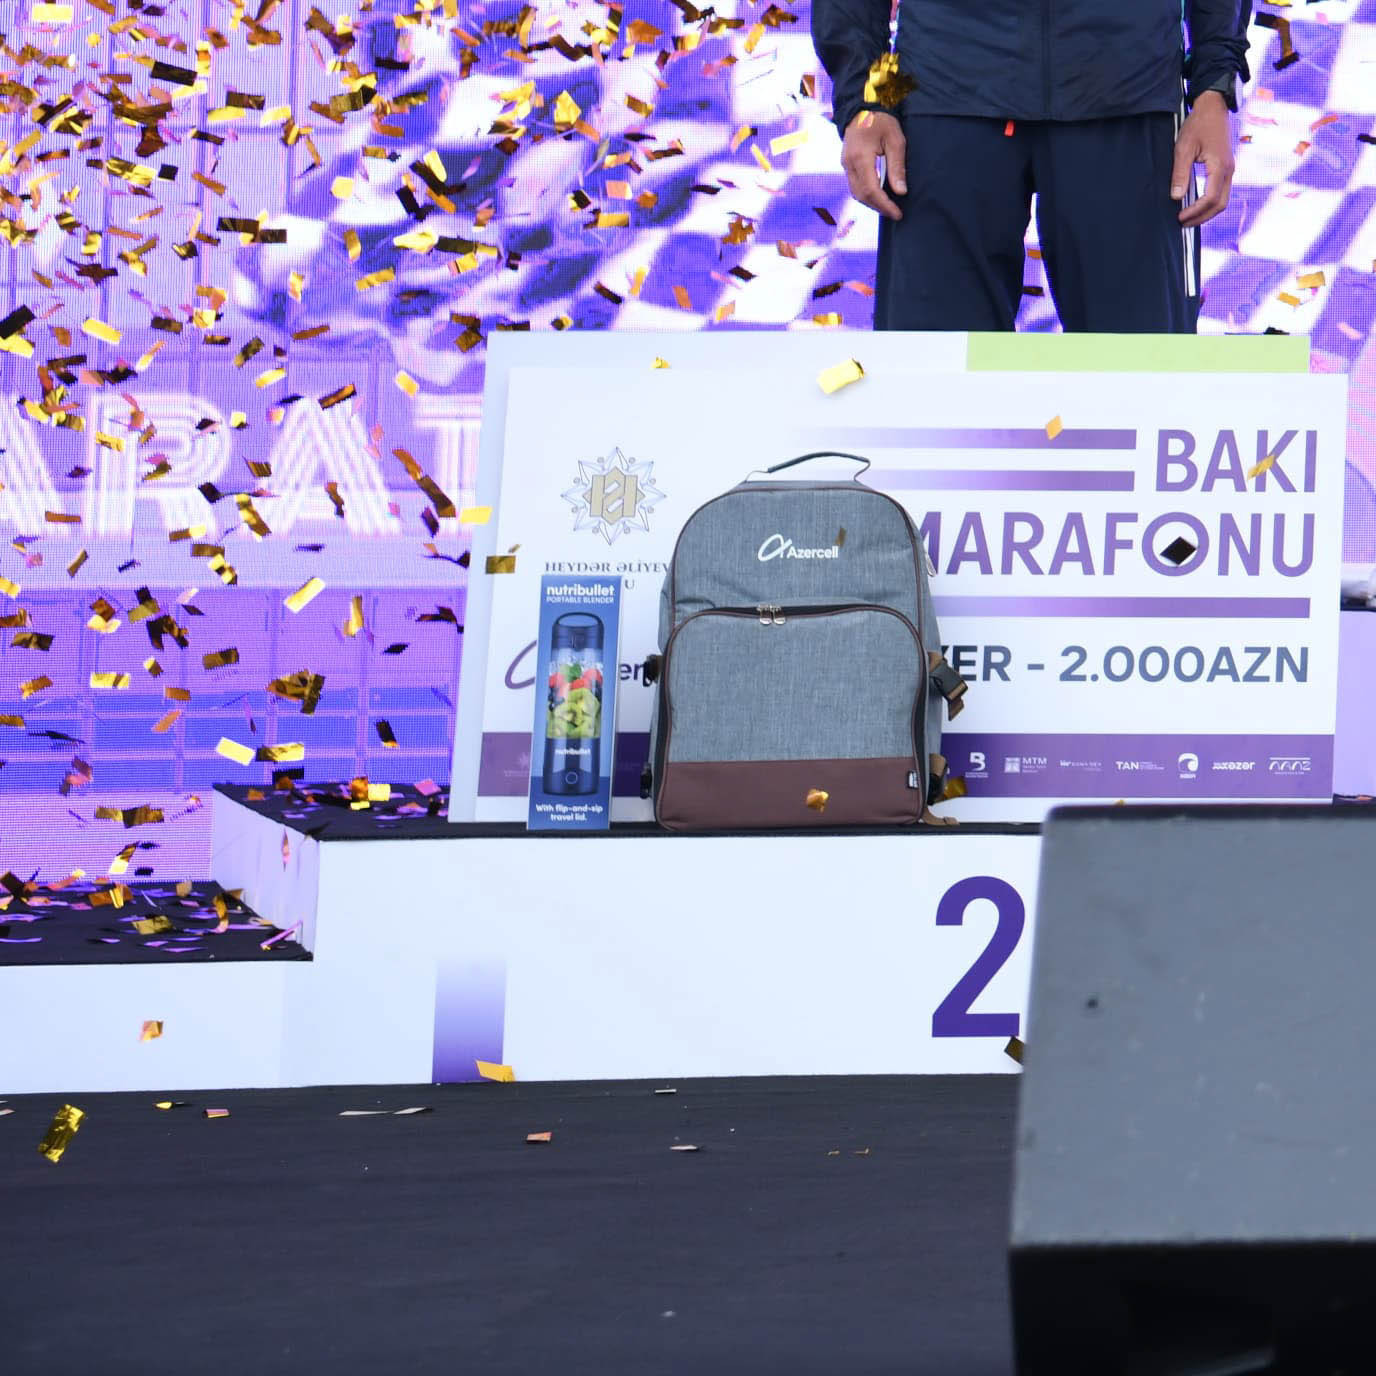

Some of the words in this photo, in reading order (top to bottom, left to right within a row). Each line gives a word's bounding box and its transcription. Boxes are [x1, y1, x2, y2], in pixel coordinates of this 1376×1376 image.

[1156, 429, 1317, 492] BAKI
[786, 545, 839, 559] Azercell
[546, 584, 615, 596] nutribullet
[546, 596, 582, 604] PORTABLE
[1059, 645, 1309, 683] 2.000AZN
[1116, 761, 1139, 770] TAN
[932, 876, 1026, 1037] 2
